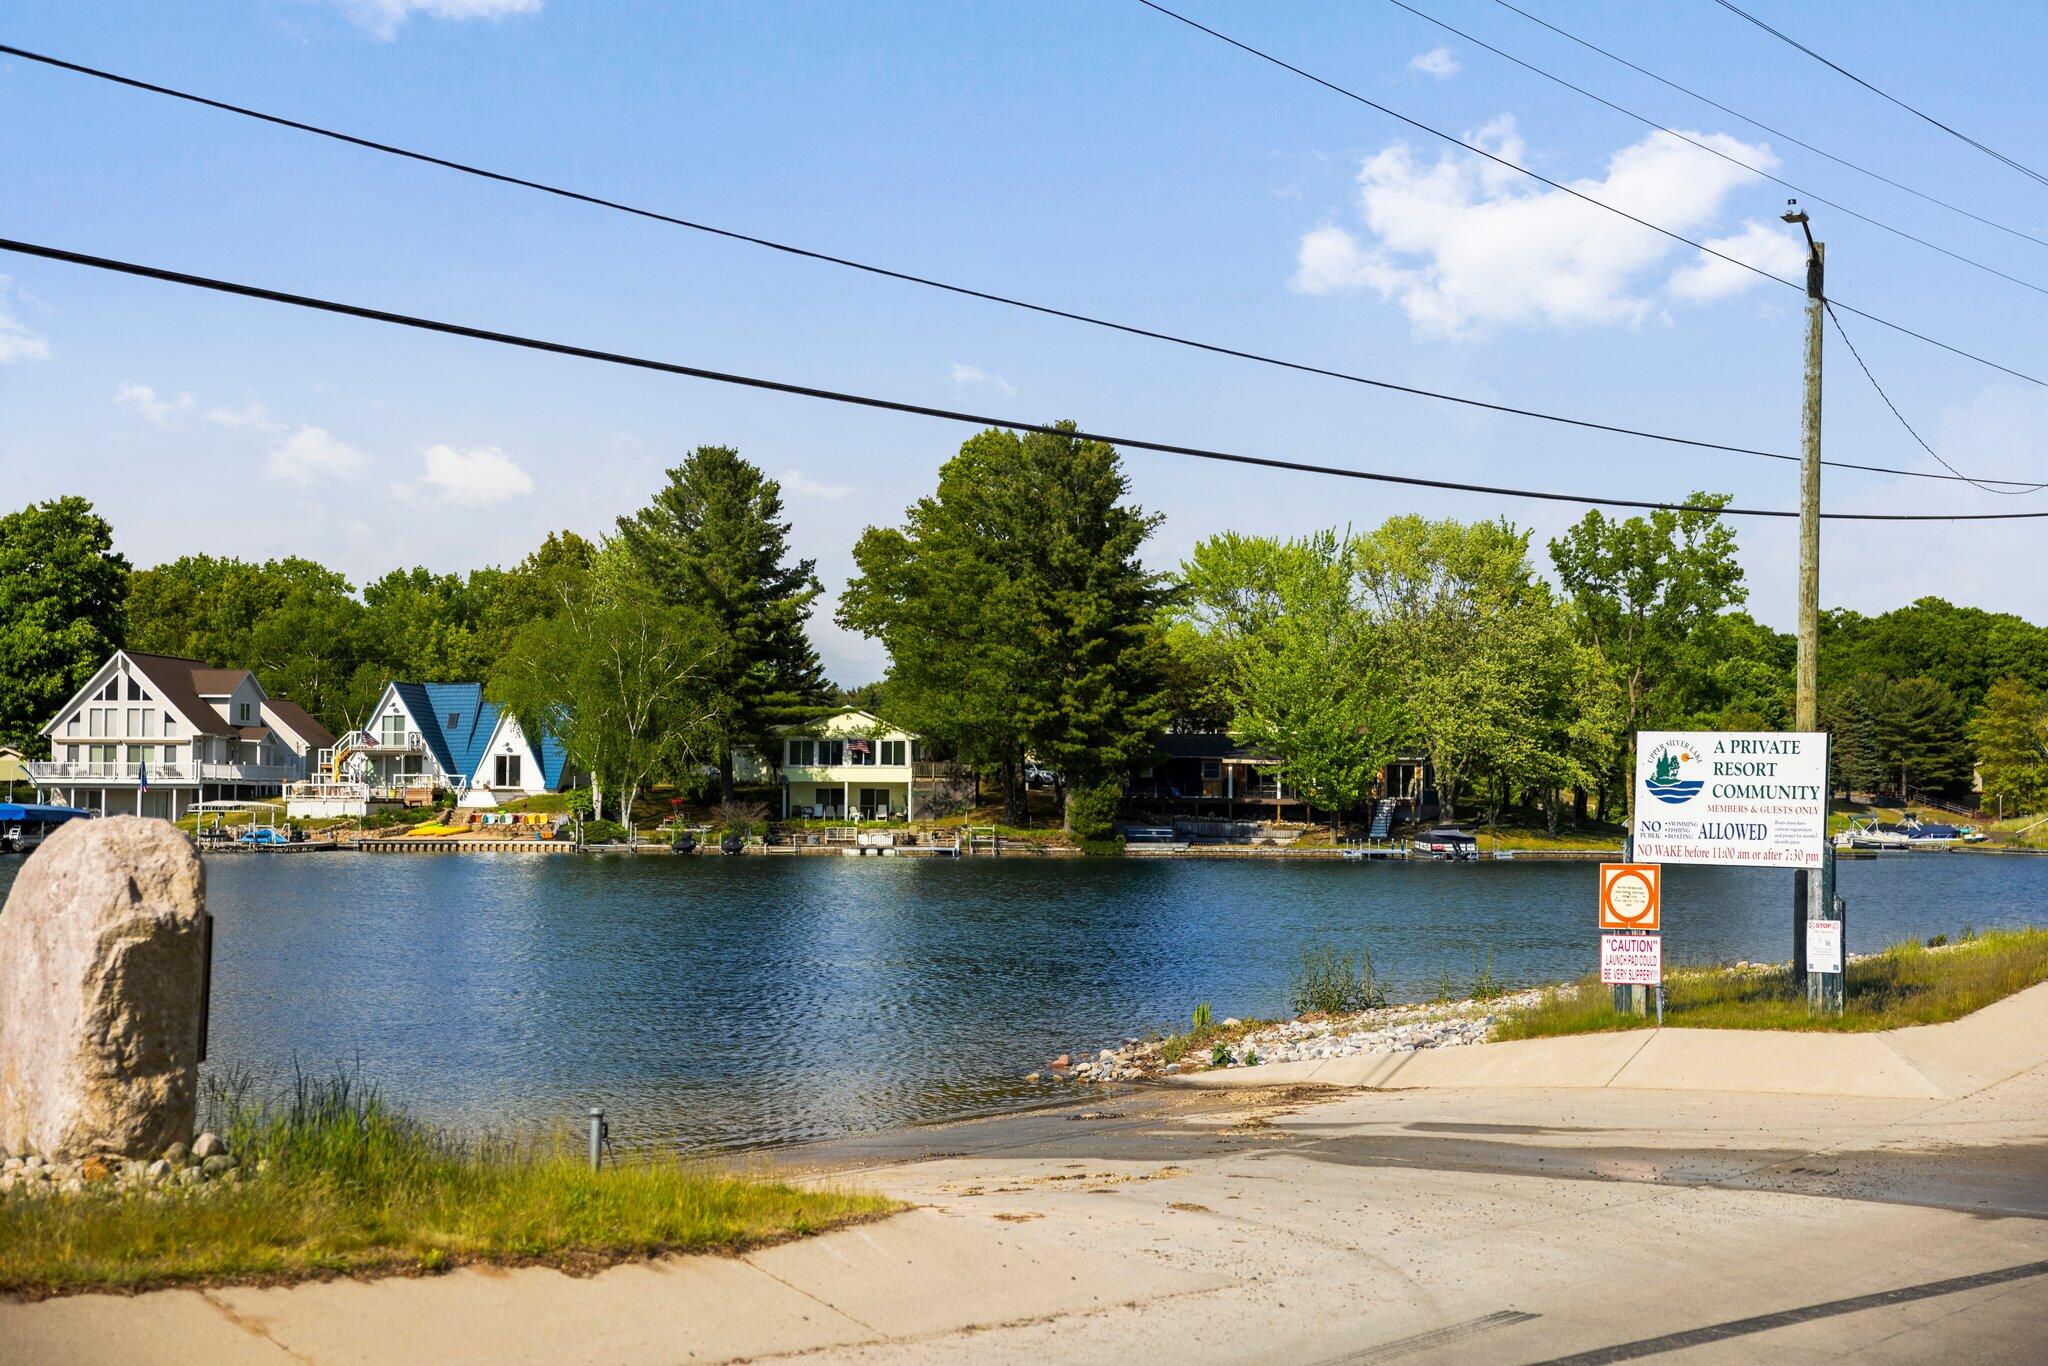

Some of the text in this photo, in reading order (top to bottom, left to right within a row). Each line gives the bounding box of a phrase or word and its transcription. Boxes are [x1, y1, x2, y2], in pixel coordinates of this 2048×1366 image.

[1689, 745, 1704, 764] LAKE
[1714, 739, 1801, 755] A PRIVATE
[1713, 761, 1778, 777] RESORT
[1712, 784, 1820, 800] COMMUNITY
[1707, 804, 1820, 815] MEMBERS & GUESTS ONLY
[1641, 820, 1662, 832] NO
[1698, 822, 1768, 841] ALLOWED
[1637, 843, 1819, 865] NO WAKE before 11:00 am or after 7:30 pm
[1606, 938, 1658, 953] "CAUTION"
[1606, 954, 1657, 967] LAUNCH PAD COULD
[1604, 968, 1612, 980] BE
[1613, 968, 1627, 980] VERY
